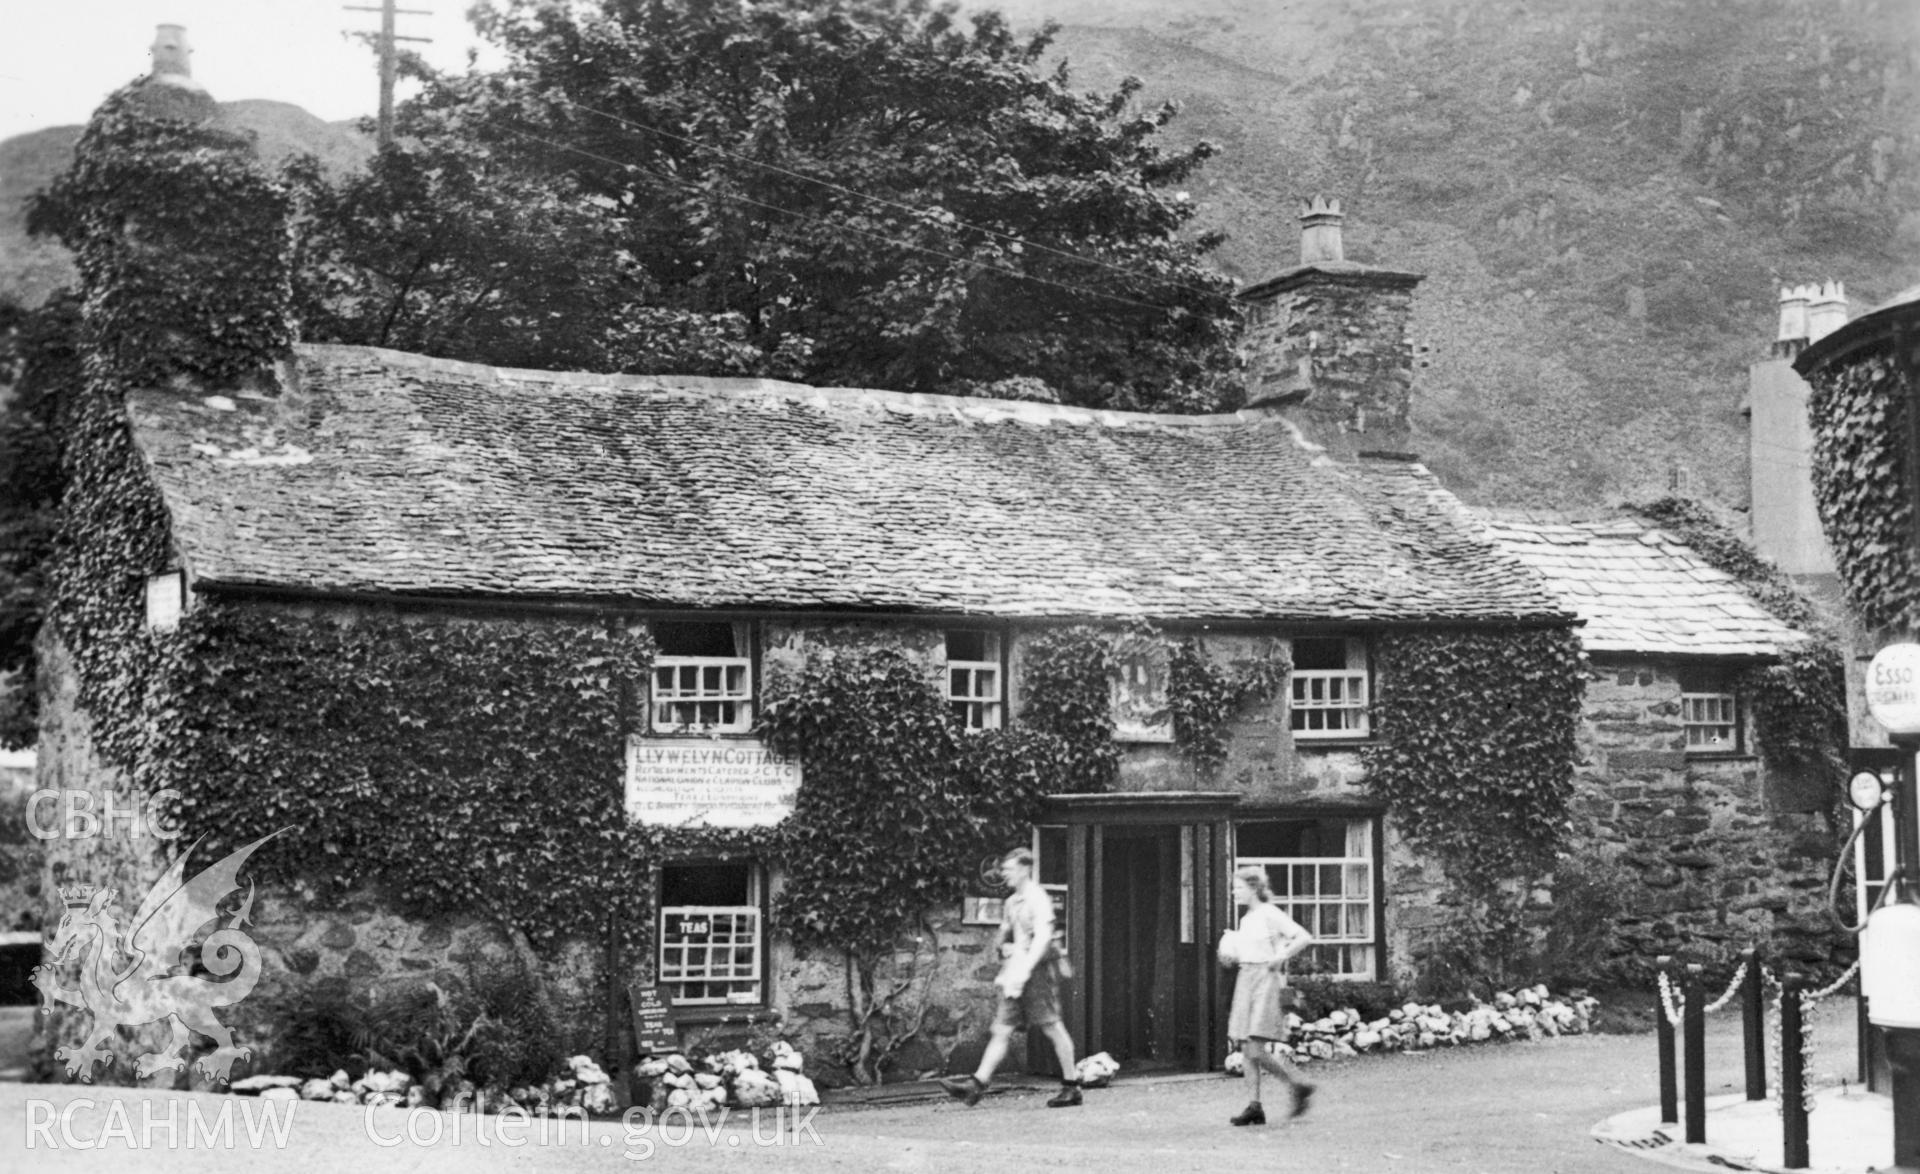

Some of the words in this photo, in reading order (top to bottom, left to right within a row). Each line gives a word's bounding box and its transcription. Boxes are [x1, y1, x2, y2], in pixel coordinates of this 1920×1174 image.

[636, 747, 722, 764] LLYWELYN
[724, 748, 793, 765] COTTAGE
[679, 921, 708, 934] TEAS
[641, 1000, 662, 1008] COLD
